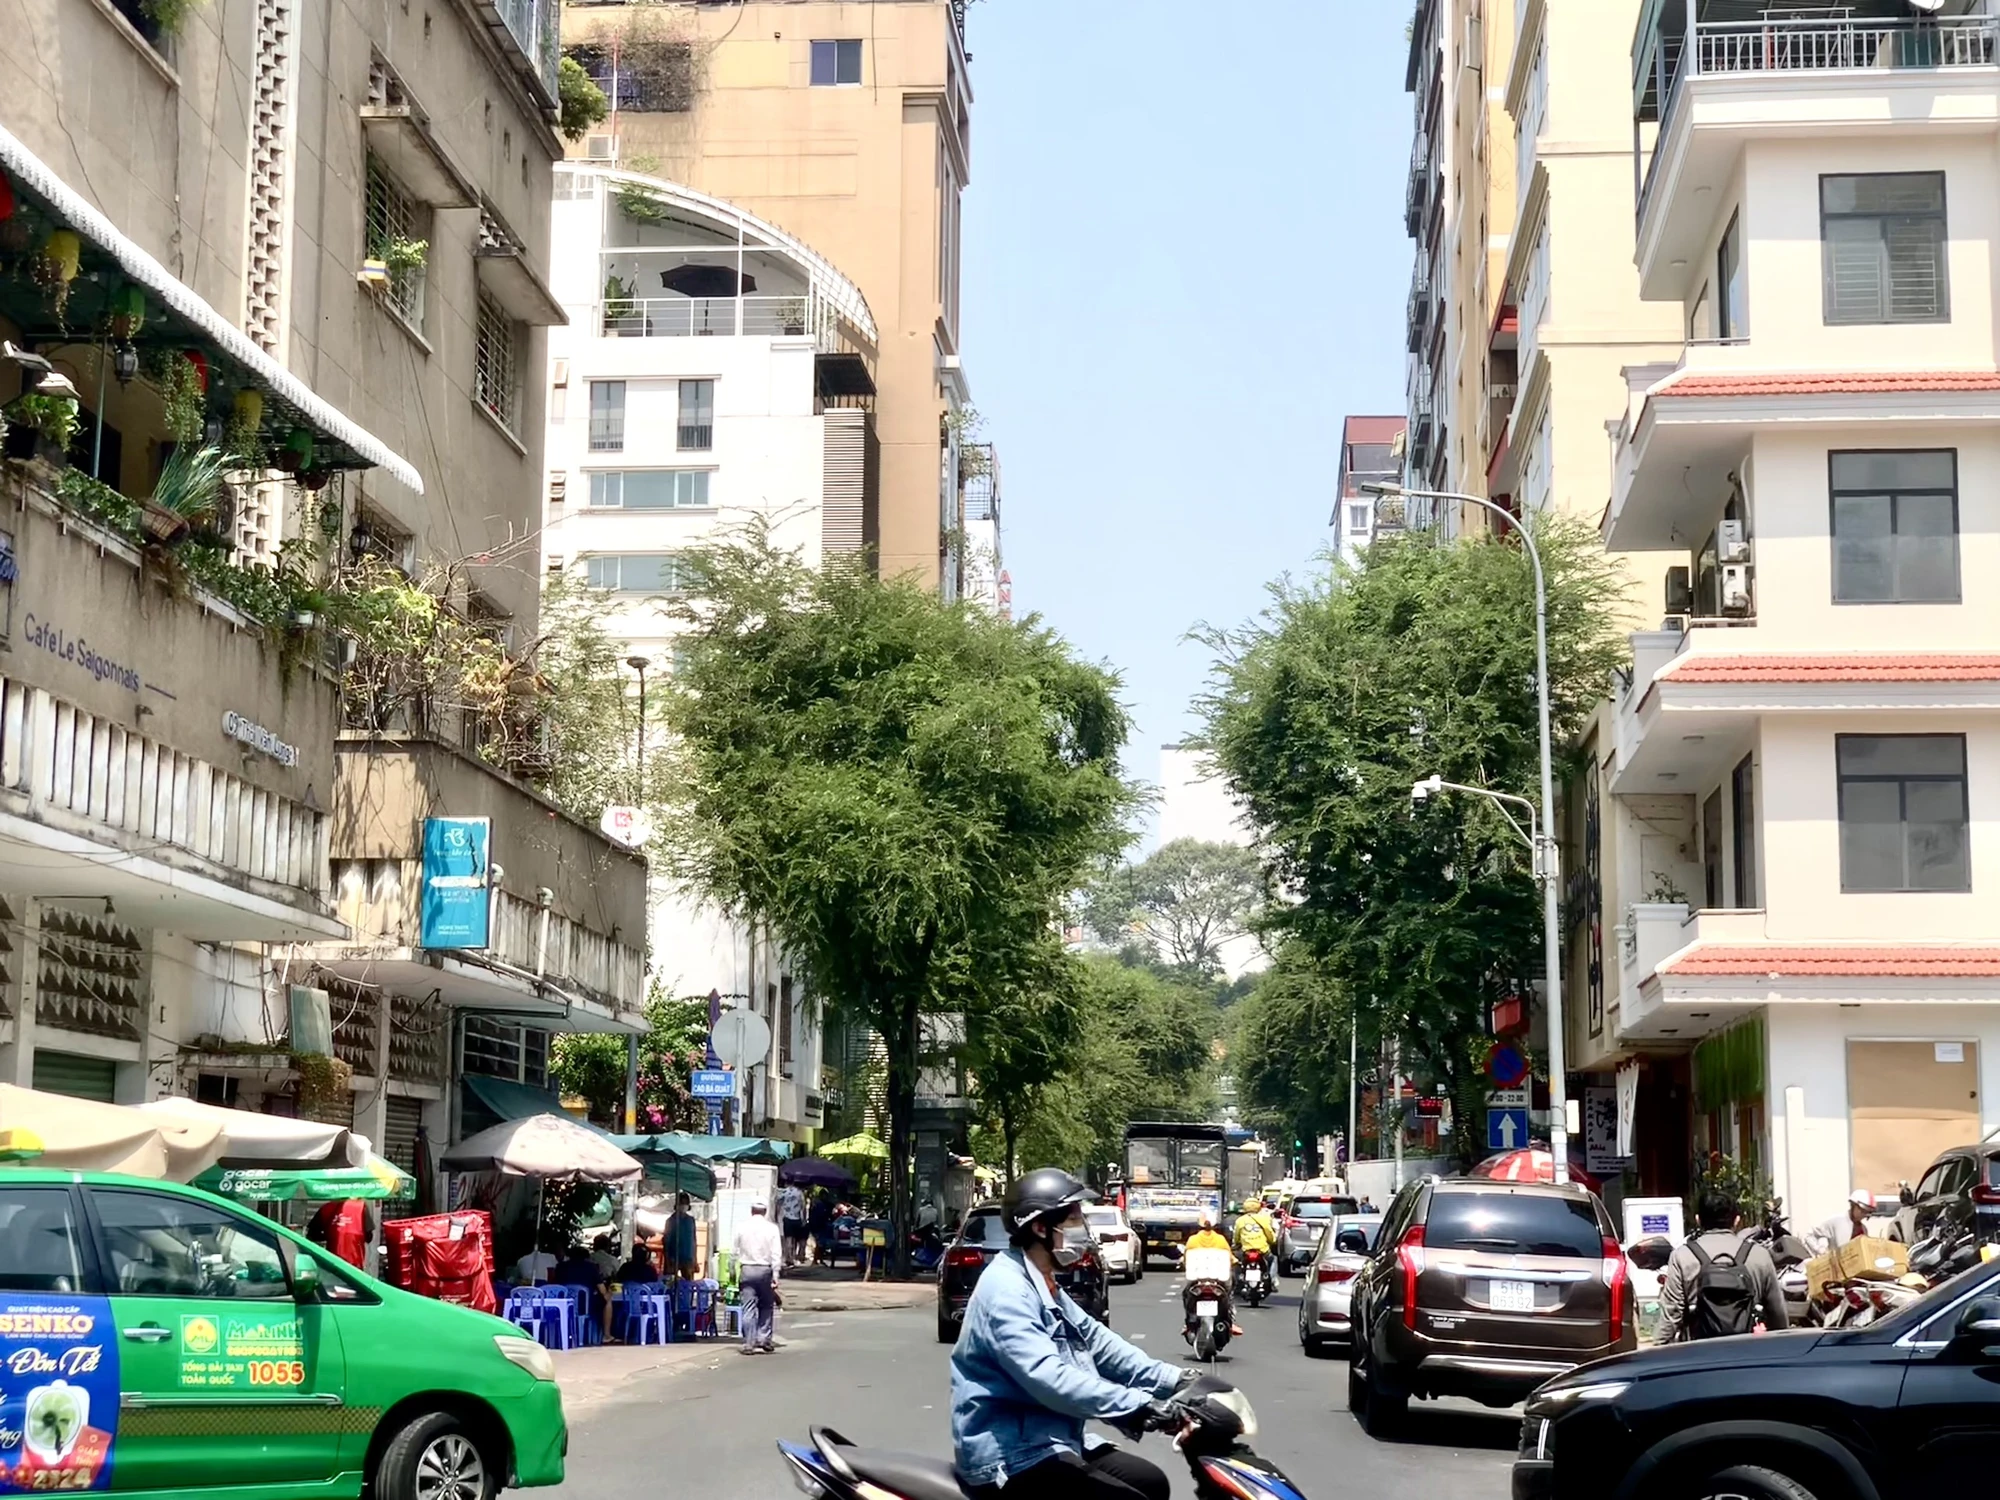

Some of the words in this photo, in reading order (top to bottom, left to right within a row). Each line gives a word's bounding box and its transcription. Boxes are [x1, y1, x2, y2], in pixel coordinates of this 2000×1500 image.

[24, 612, 57, 653] Cafe
[58, 630, 74, 661] Le
[77, 638, 140, 692] Saigonnais
[694, 1084, 705, 1093] CAO
[705, 1082, 715, 1093] BÁ
[714, 1082, 731, 1093] QUÁT
[224, 1169, 274, 1179] gocar
[235, 1180, 273, 1192] gocar
[0, 1314, 94, 1334] SENKO
[59, 1344, 104, 1376] Tết
[225, 1362, 245, 1373] TAXI
[248, 1361, 305, 1385] 1055
[182, 1373, 207, 1384] TOÀN
[208, 1373, 235, 1385] QUỐC
